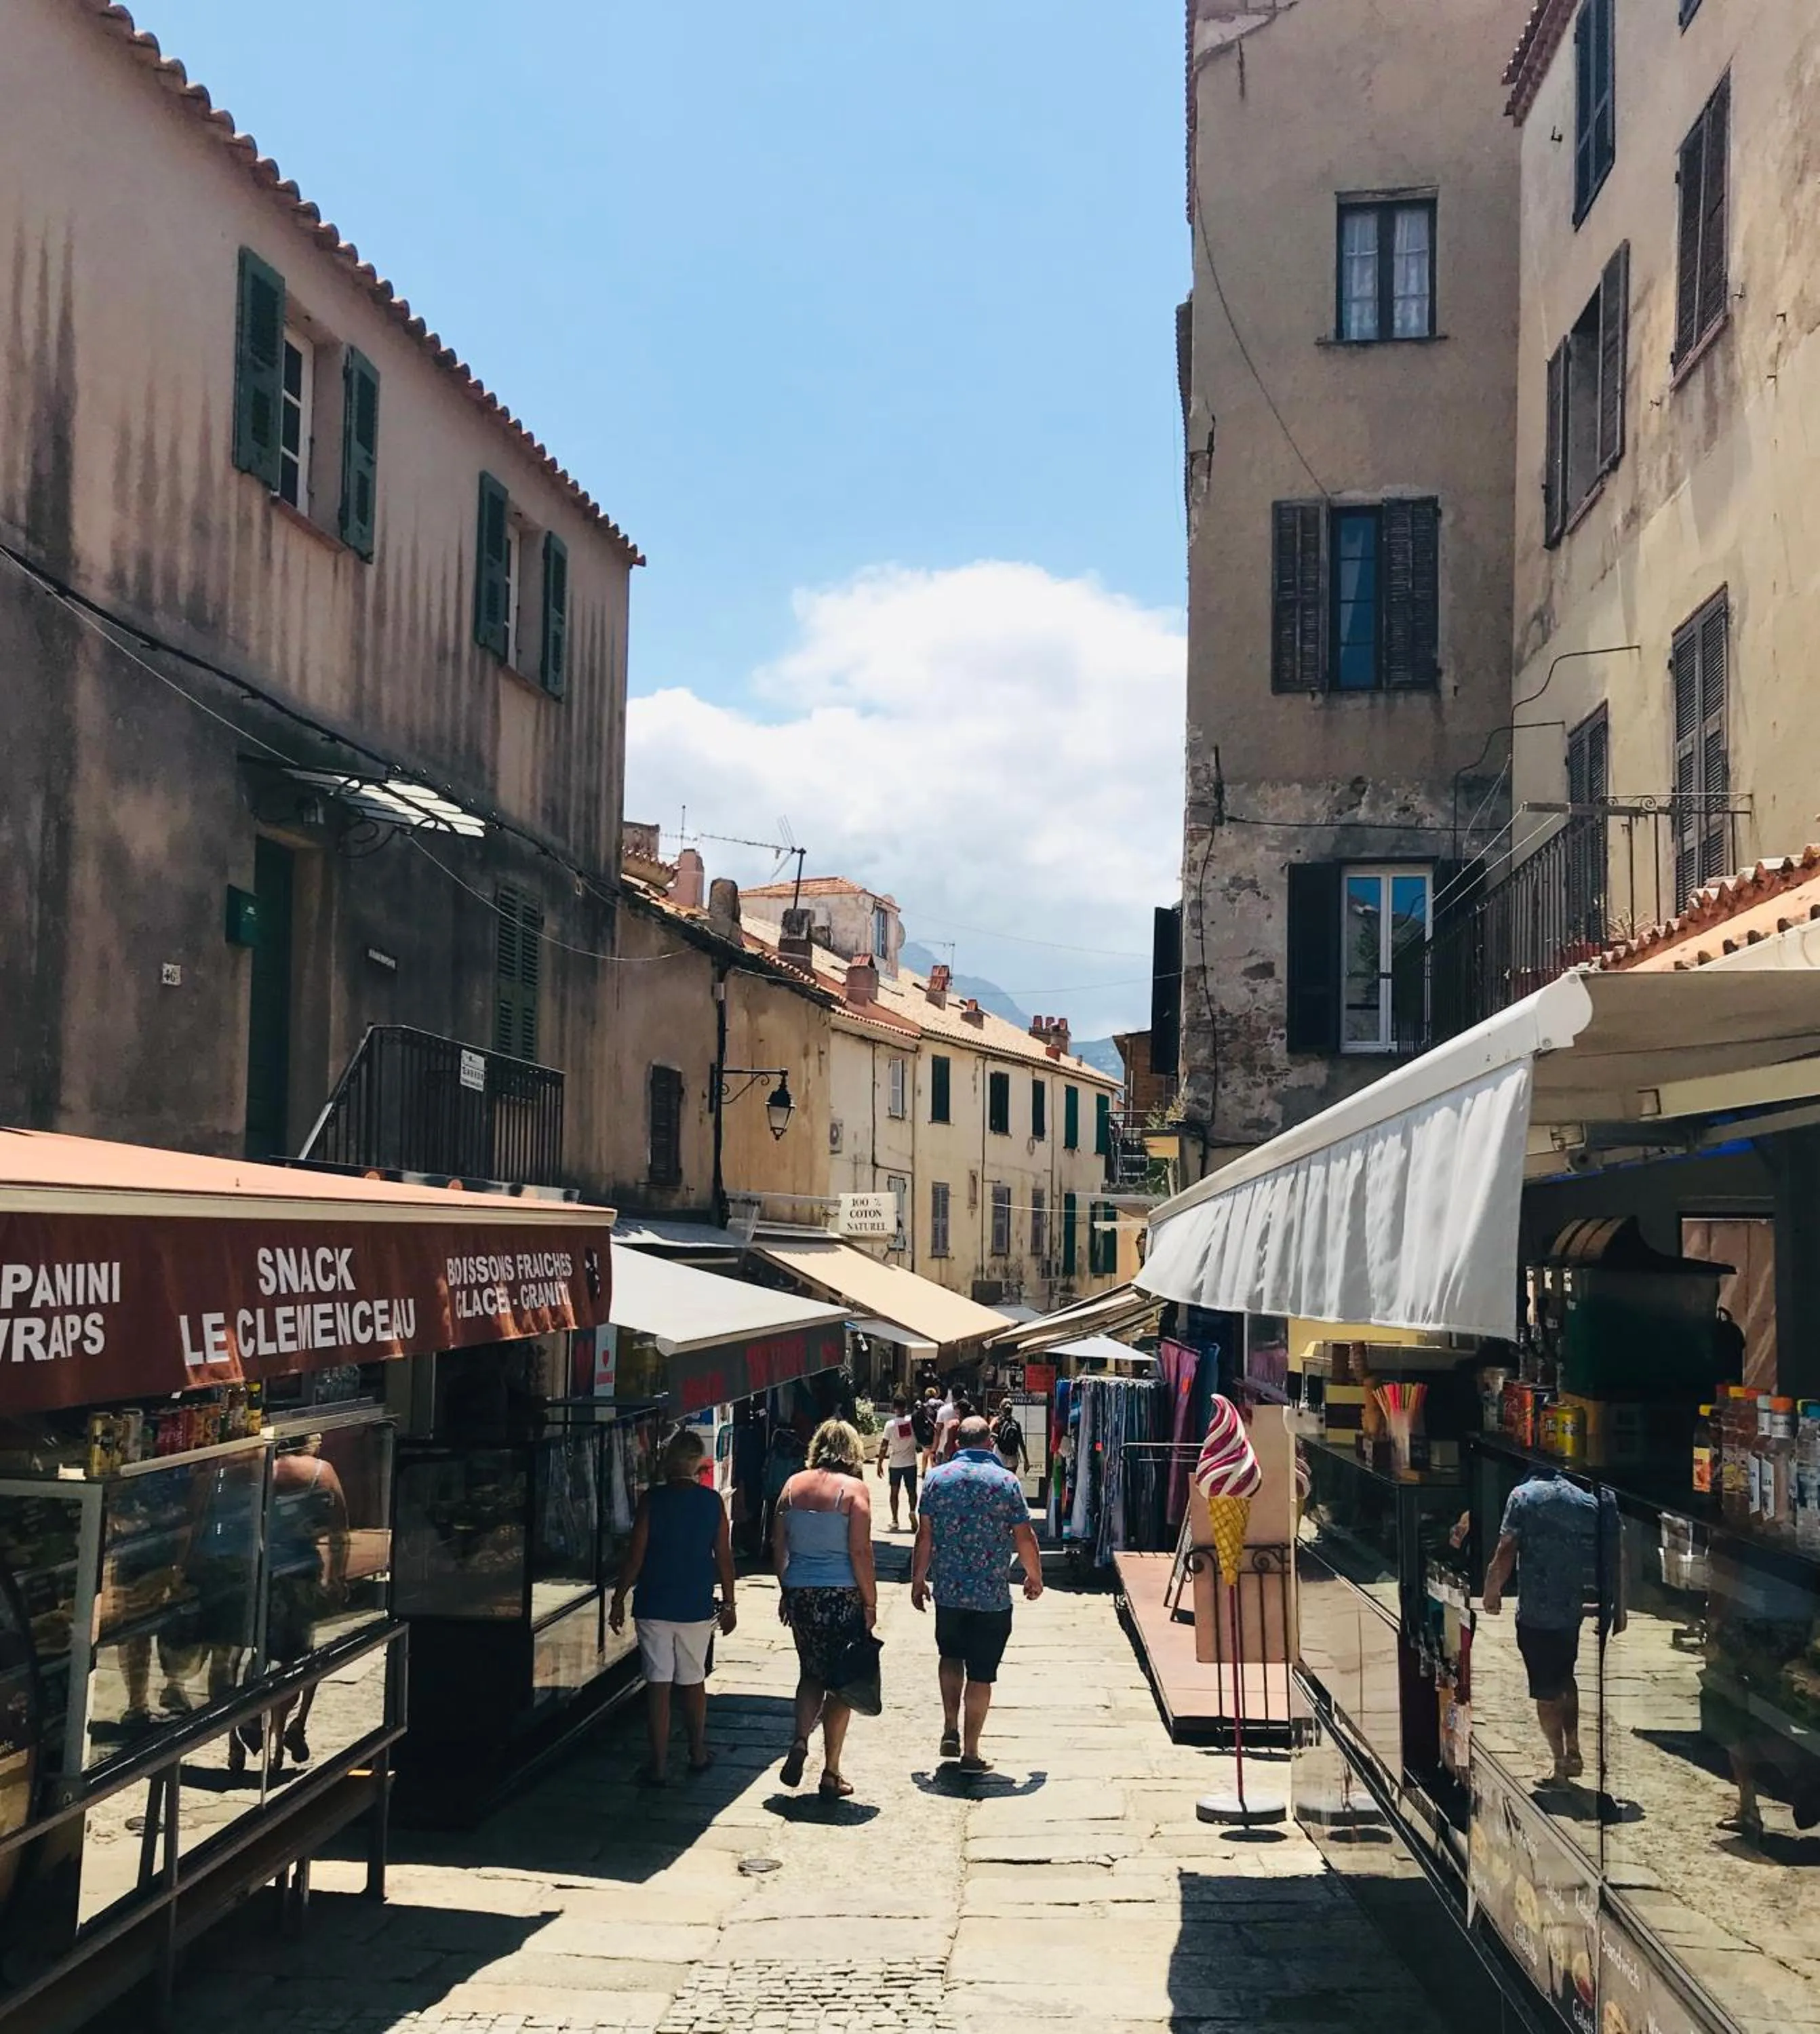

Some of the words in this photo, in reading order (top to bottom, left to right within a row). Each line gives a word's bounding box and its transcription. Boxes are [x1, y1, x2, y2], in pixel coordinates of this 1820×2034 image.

[850, 1210, 884, 1218] COTON
[852, 1198, 869, 1207] 100
[846, 1222, 887, 1231] NATUREL
[0, 1262, 120, 1309] PANINI
[257, 1247, 356, 1296] SNACK
[446, 1255, 515, 1286] BOISSONS
[179, 1312, 231, 1367] LE
[237, 1298, 416, 1358] CLEMENCEAU
